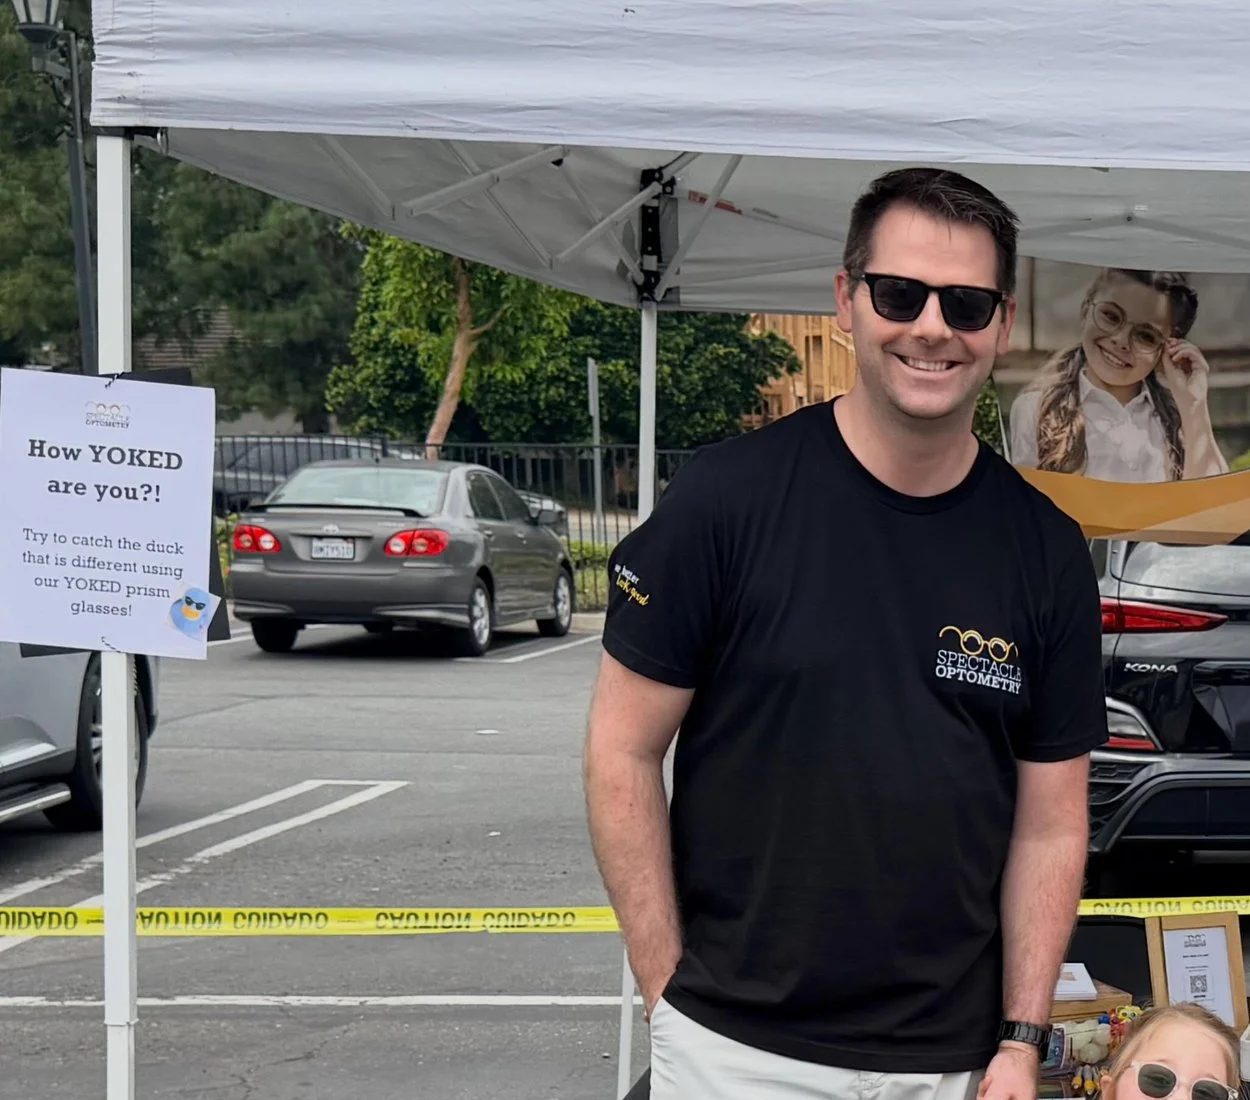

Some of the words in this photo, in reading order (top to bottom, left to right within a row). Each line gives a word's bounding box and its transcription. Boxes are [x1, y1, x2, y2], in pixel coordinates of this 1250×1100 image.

[27, 438, 82, 461] How
[88, 444, 183, 470] YOKED
[47, 479, 87, 496] are
[94, 483, 161, 503] you?!
[22, 527, 48, 546] Try
[53, 531, 67, 545] to
[72, 534, 113, 549] catch
[117, 537, 142, 551] the
[146, 539, 184, 555] duck
[22, 551, 50, 566] that
[54, 553, 67, 567] is
[72, 555, 137, 573] different
[141, 563, 184, 580] using
[34, 576, 59, 589] our
[64, 576, 121, 594] YOKED
[125, 583, 170, 599] prism
[70, 600, 132, 617] glasses!
[935, 664, 1022, 695] OPTOMETRY
[936, 649, 1022, 682] SPECTACLE
[1123, 662, 1178, 673] KONA
